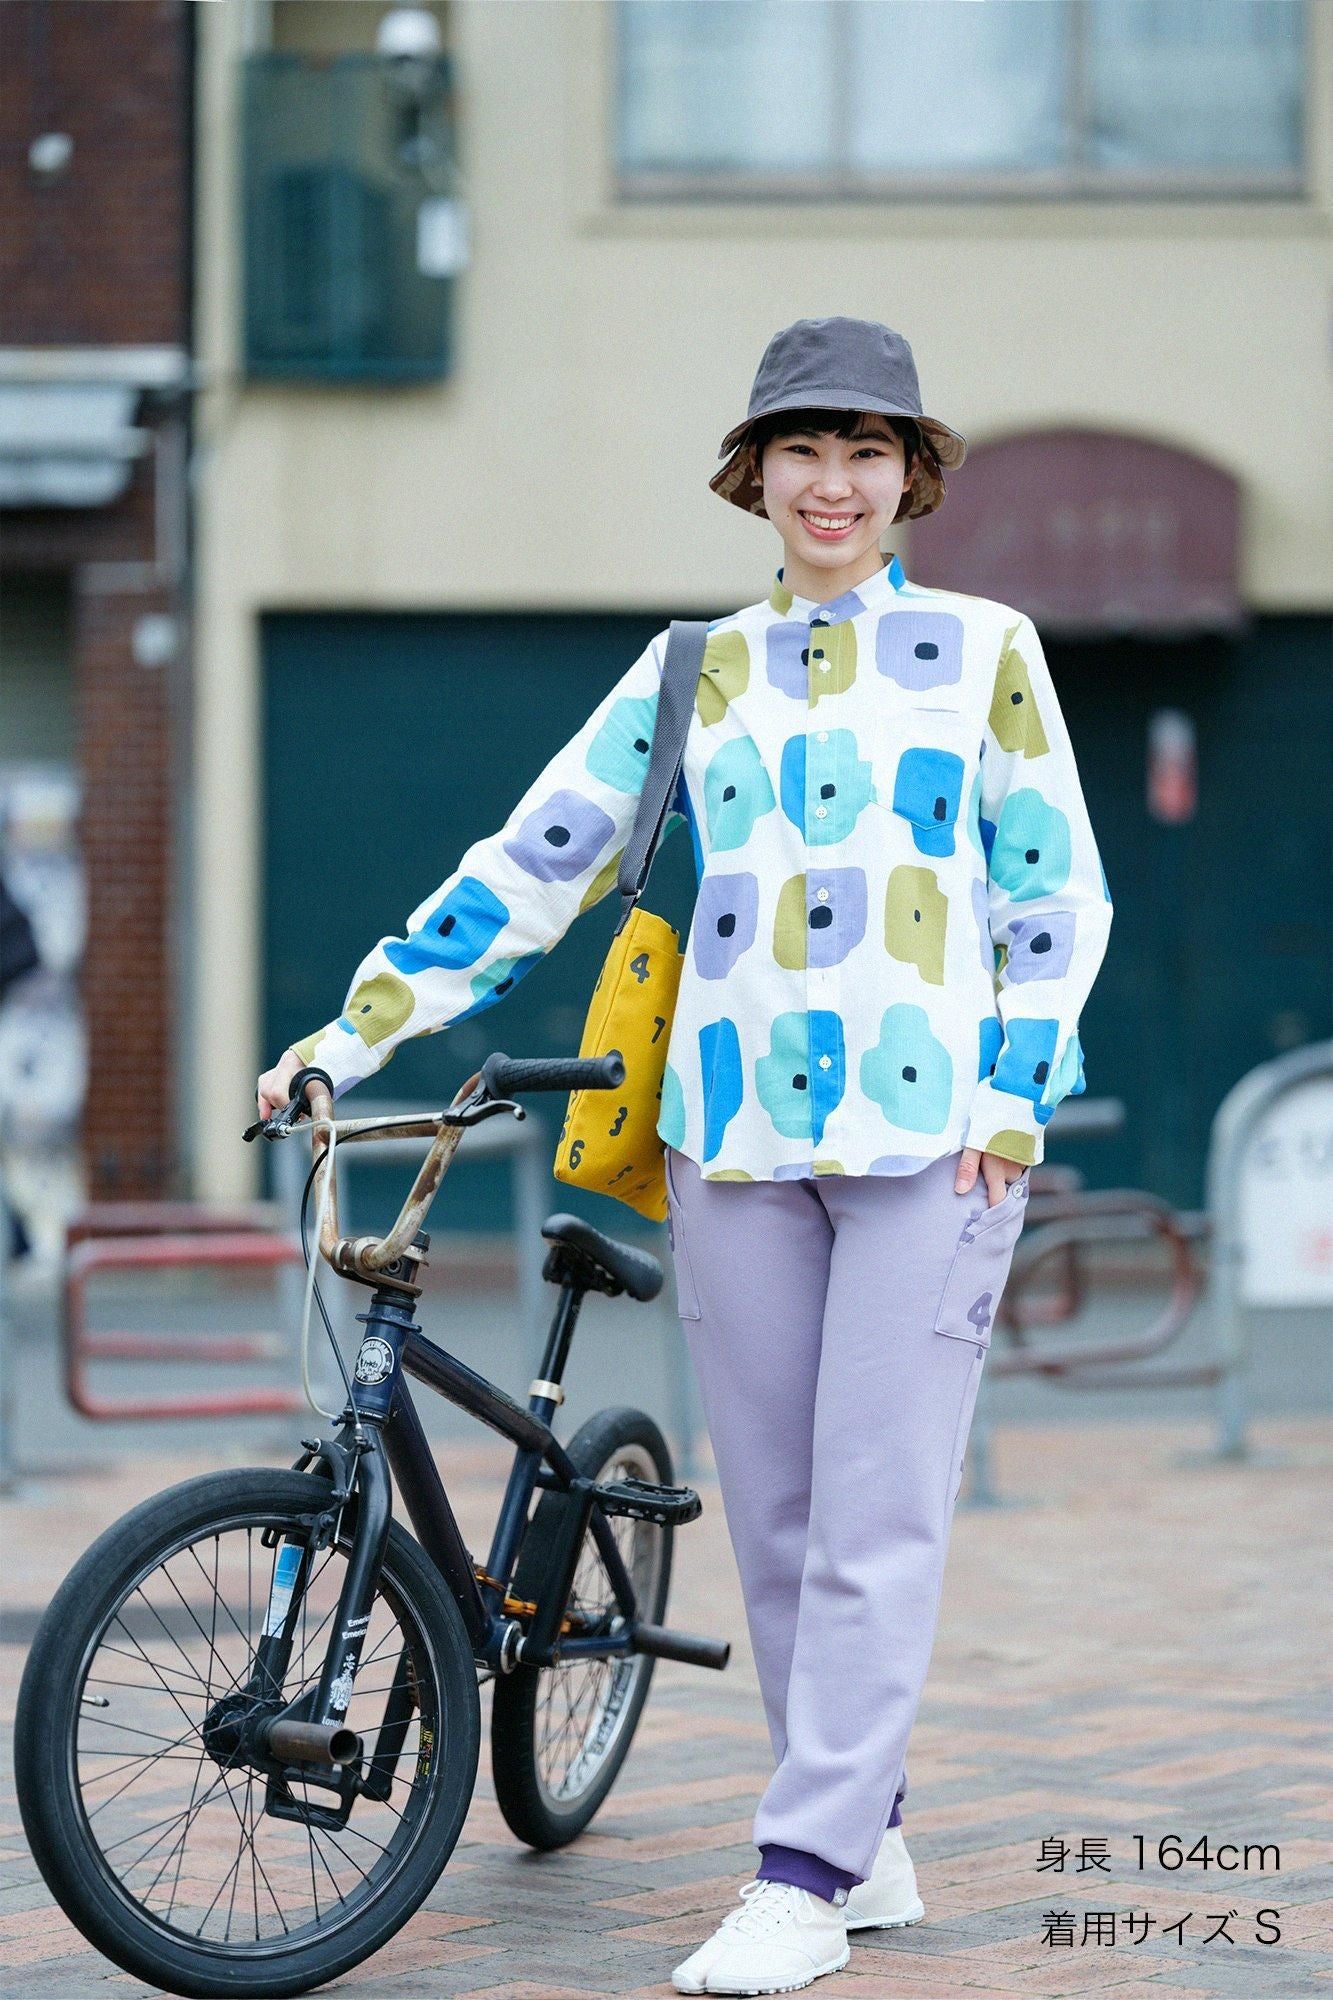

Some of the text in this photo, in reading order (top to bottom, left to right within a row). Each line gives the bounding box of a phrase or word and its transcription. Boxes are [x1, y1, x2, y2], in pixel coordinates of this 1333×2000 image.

[630, 952, 650, 984] 4
[651, 1015, 666, 1044] 7
[608, 1106, 628, 1137] 3
[569, 1139, 586, 1171] 6
[967, 1292, 992, 1335] 4
